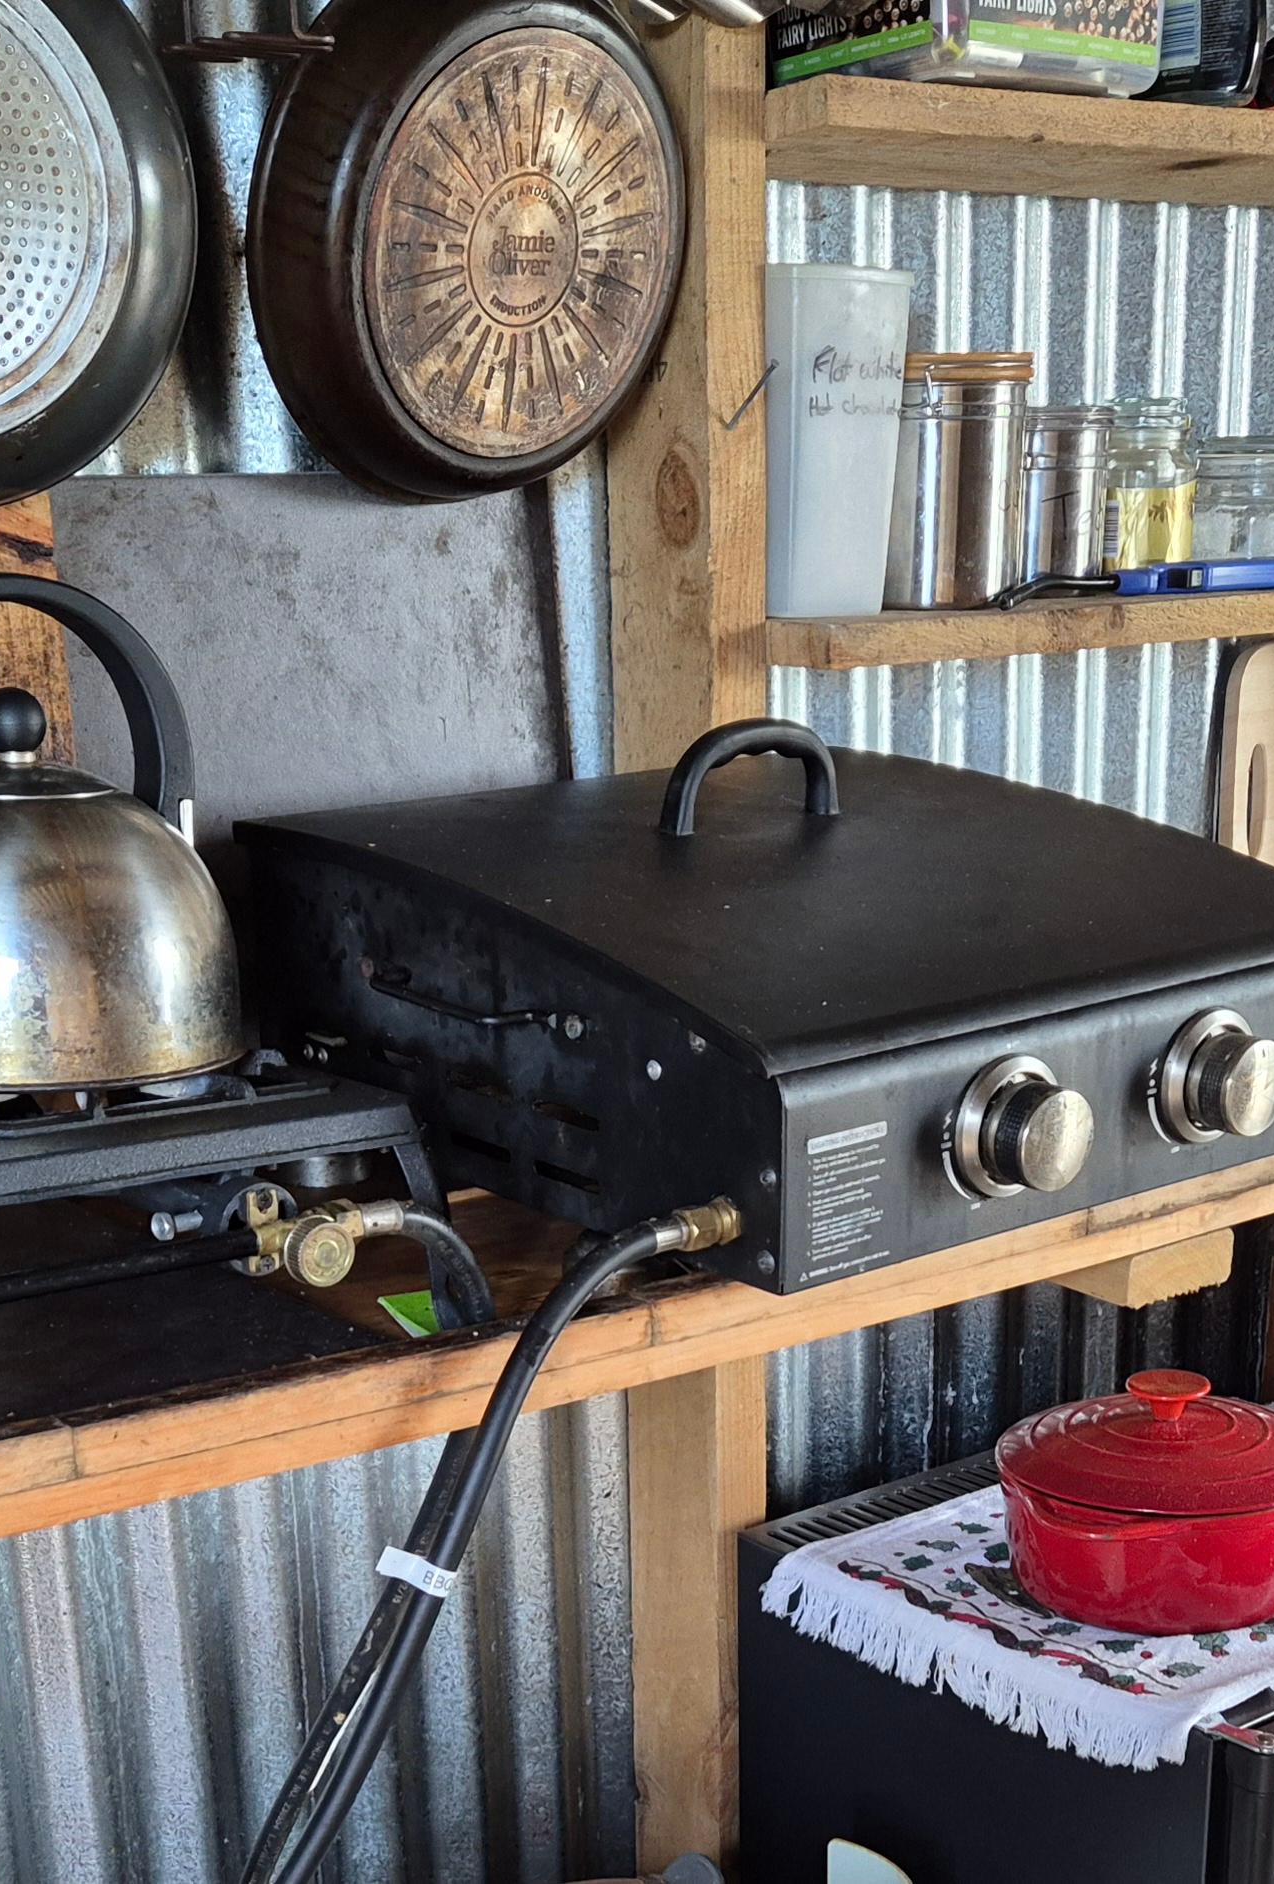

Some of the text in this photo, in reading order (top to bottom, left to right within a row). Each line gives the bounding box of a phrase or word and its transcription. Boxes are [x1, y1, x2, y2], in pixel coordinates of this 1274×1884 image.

[776, 21, 805, 50] FAIRY
[807, 16, 848, 41] LIGHTS
[518, 184, 567, 226] ANODISED
[492, 225, 556, 254] Jamie
[489, 251, 552, 277] Oliver
[489, 293, 548, 317] INDUCTION
[809, 392, 834, 418] Hot
